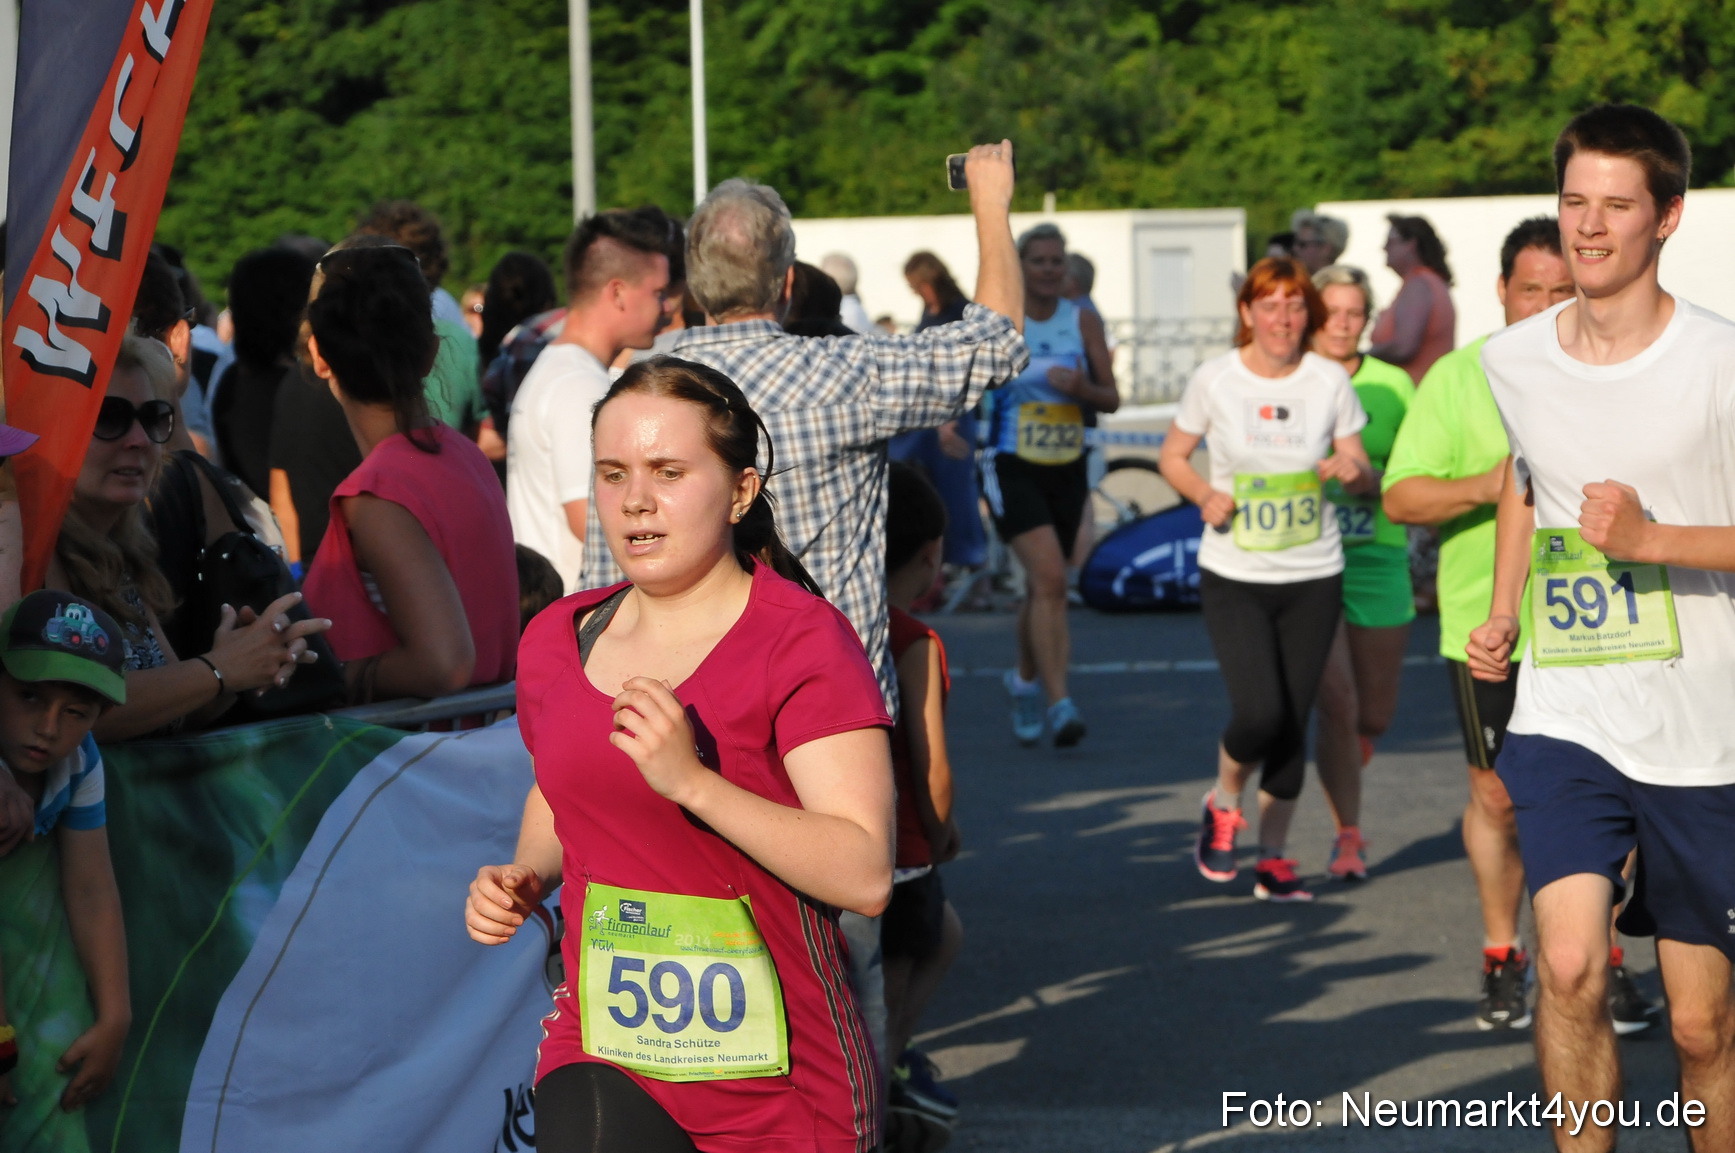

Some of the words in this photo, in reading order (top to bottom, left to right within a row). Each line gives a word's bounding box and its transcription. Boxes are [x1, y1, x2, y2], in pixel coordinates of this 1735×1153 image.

[1024, 422, 1078, 448] 1232
[1239, 497, 1317, 531] 1013
[1546, 571, 1640, 631] 591
[1569, 633, 1595, 642] Markus
[1597, 630, 1632, 641] Batzdorf
[1542, 646, 1570, 655] Kliniken
[1571, 645, 1583, 654] des
[1584, 644, 1627, 654] Landkreises
[1629, 640, 1666, 649] Neumarkt
[607, 918, 673, 938] firmenlauf
[607, 931, 636, 939] neumarkt
[674, 933, 712, 947] 2014
[607, 955, 746, 1034] 590
[636, 1034, 672, 1049] Sandra
[674, 1037, 721, 1049] Schütze
[597, 1045, 633, 1060] Kliniken
[635, 1051, 652, 1062] des
[654, 1053, 715, 1064] Landkreises
[717, 1051, 769, 1063] Neumarkt
